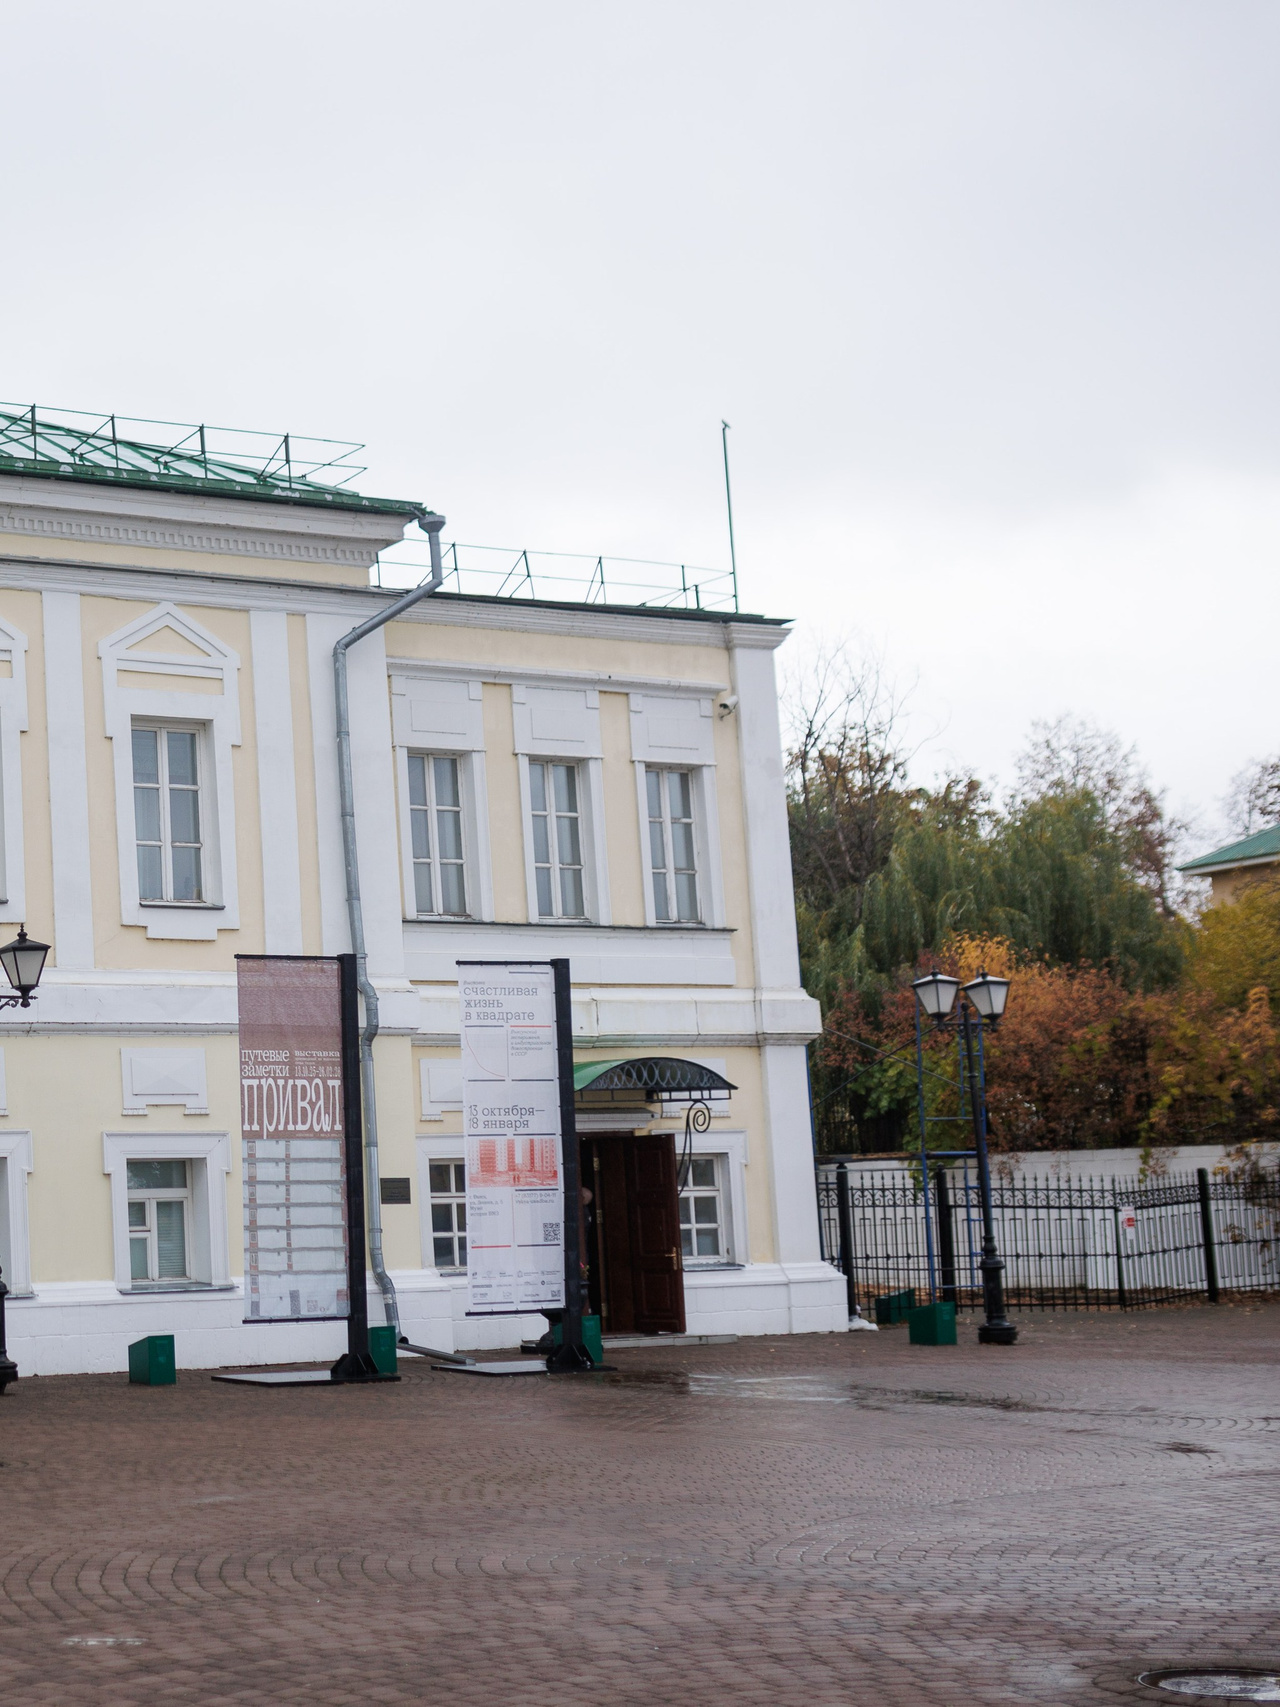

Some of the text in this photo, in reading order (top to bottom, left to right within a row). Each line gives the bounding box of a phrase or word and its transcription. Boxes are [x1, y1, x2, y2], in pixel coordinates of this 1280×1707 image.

[463, 986, 538, 996] счастливая
[464, 999, 504, 1008] жизнь
[465, 1011, 535, 1023] в квадрате
[241, 1049, 290, 1066] путевые
[241, 1065, 290, 1077] заметки
[242, 1078, 342, 1139] привал
[468, 1104, 478, 1117] 13
[468, 1117, 529, 1131] 18 января
